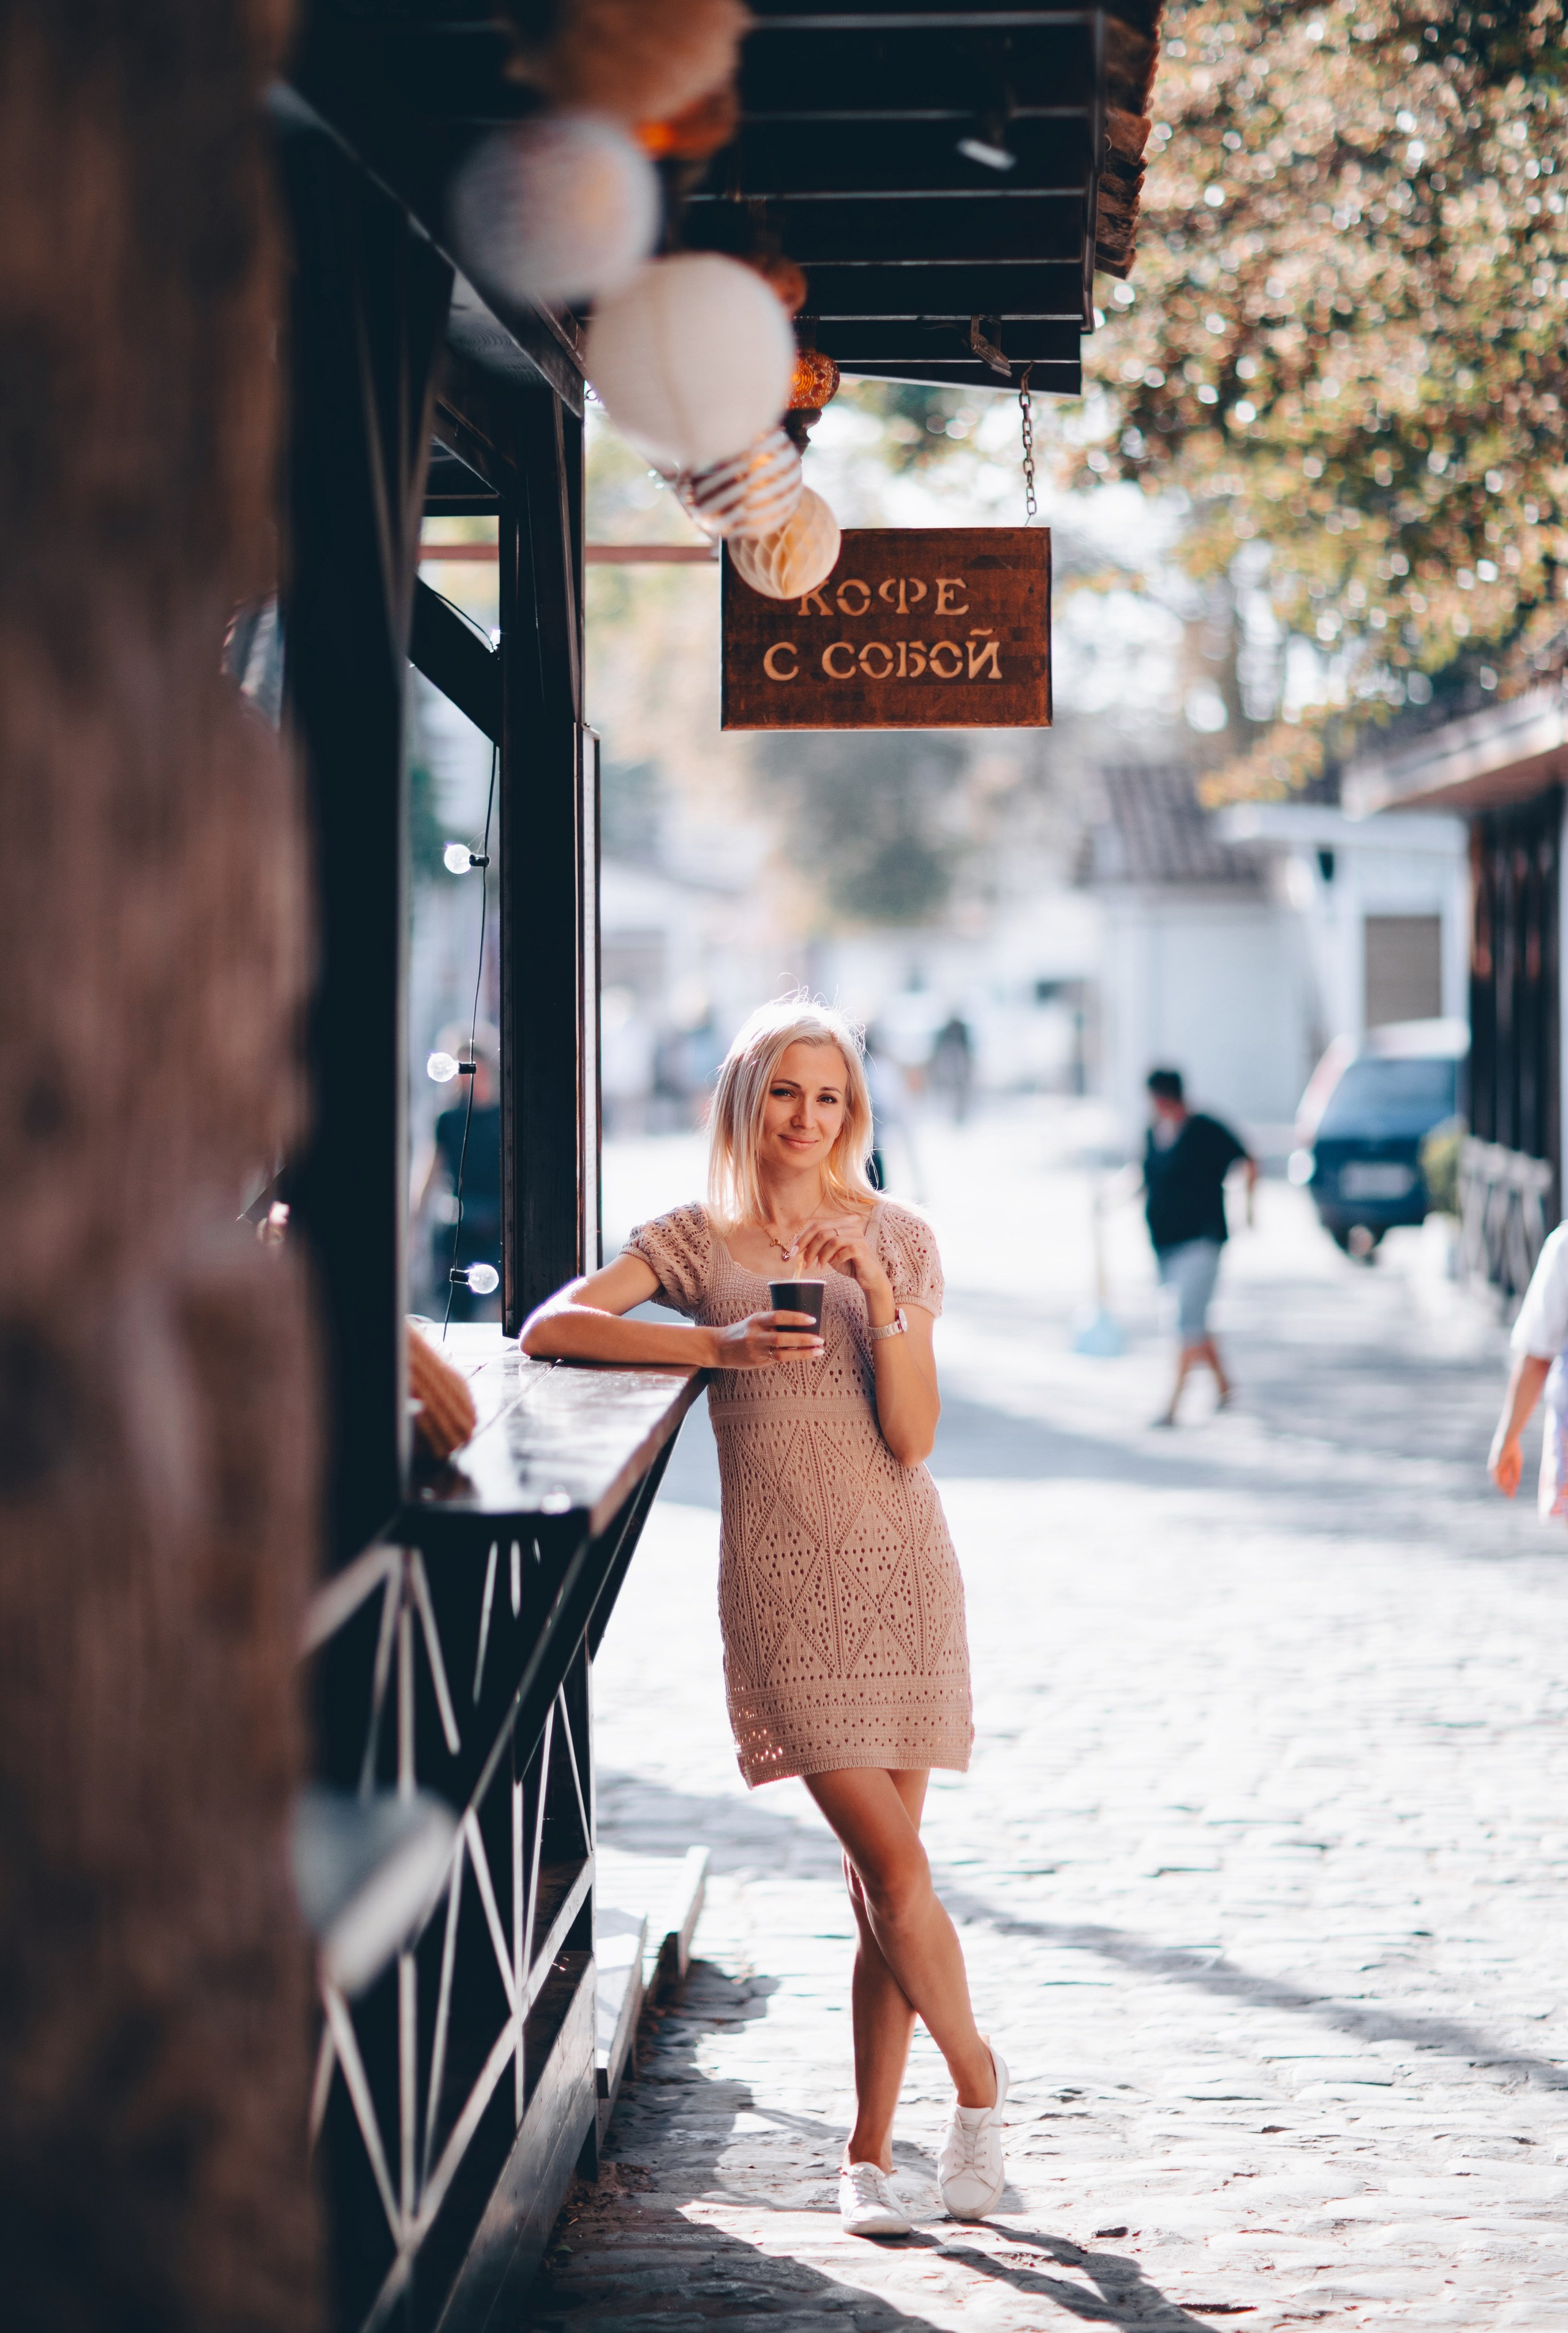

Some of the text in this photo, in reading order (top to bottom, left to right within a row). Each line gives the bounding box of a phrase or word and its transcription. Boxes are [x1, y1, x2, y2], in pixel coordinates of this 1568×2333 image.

[798, 578, 969, 616] КОФЕ
[763, 628, 1003, 681] С СОБОЙ
